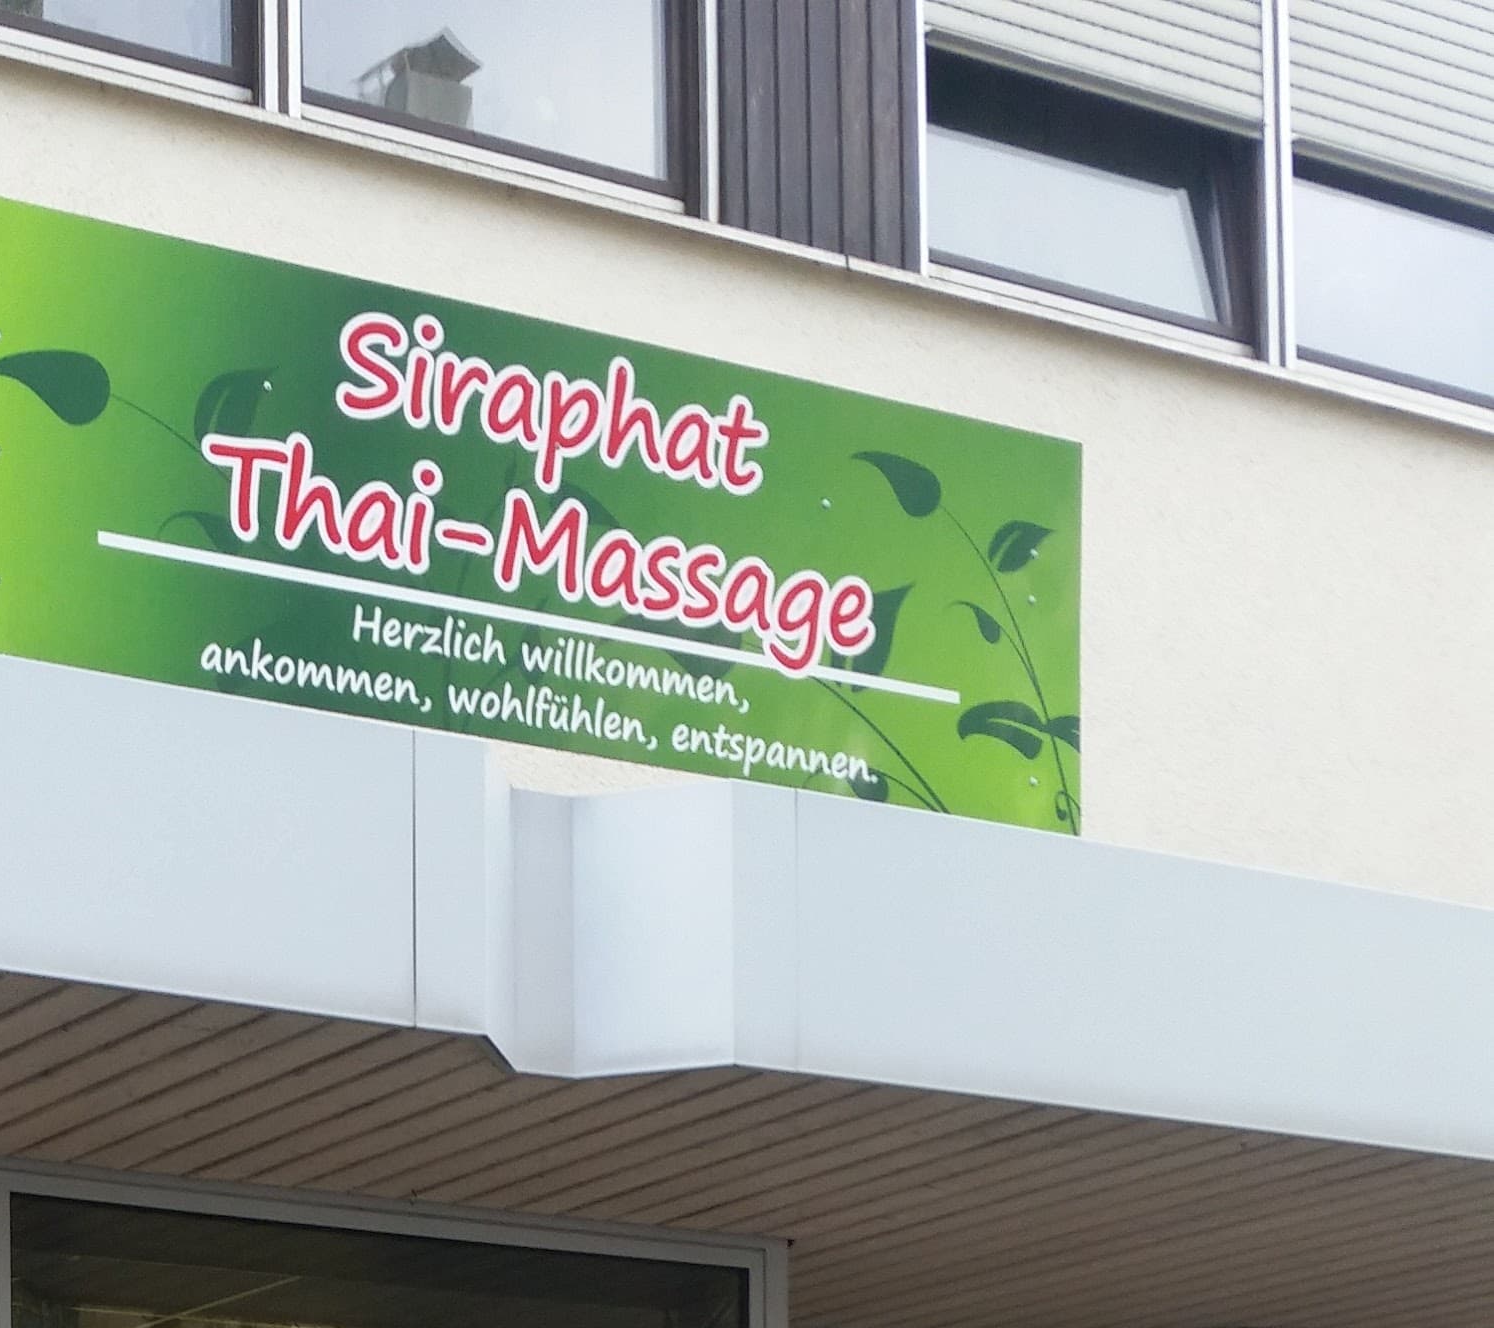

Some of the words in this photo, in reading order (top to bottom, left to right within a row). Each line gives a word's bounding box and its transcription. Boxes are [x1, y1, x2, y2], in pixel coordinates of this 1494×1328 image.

[336, 312, 768, 493] Siraphat
[202, 434, 876, 674] Thai-Massage
[200, 641, 434, 713] ankommen,
[448, 681, 659, 751] wohlfühlen,
[671, 725, 879, 785] entspannen.
[352, 604, 506, 667] Herzlich
[521, 637, 750, 714] willkommen,
